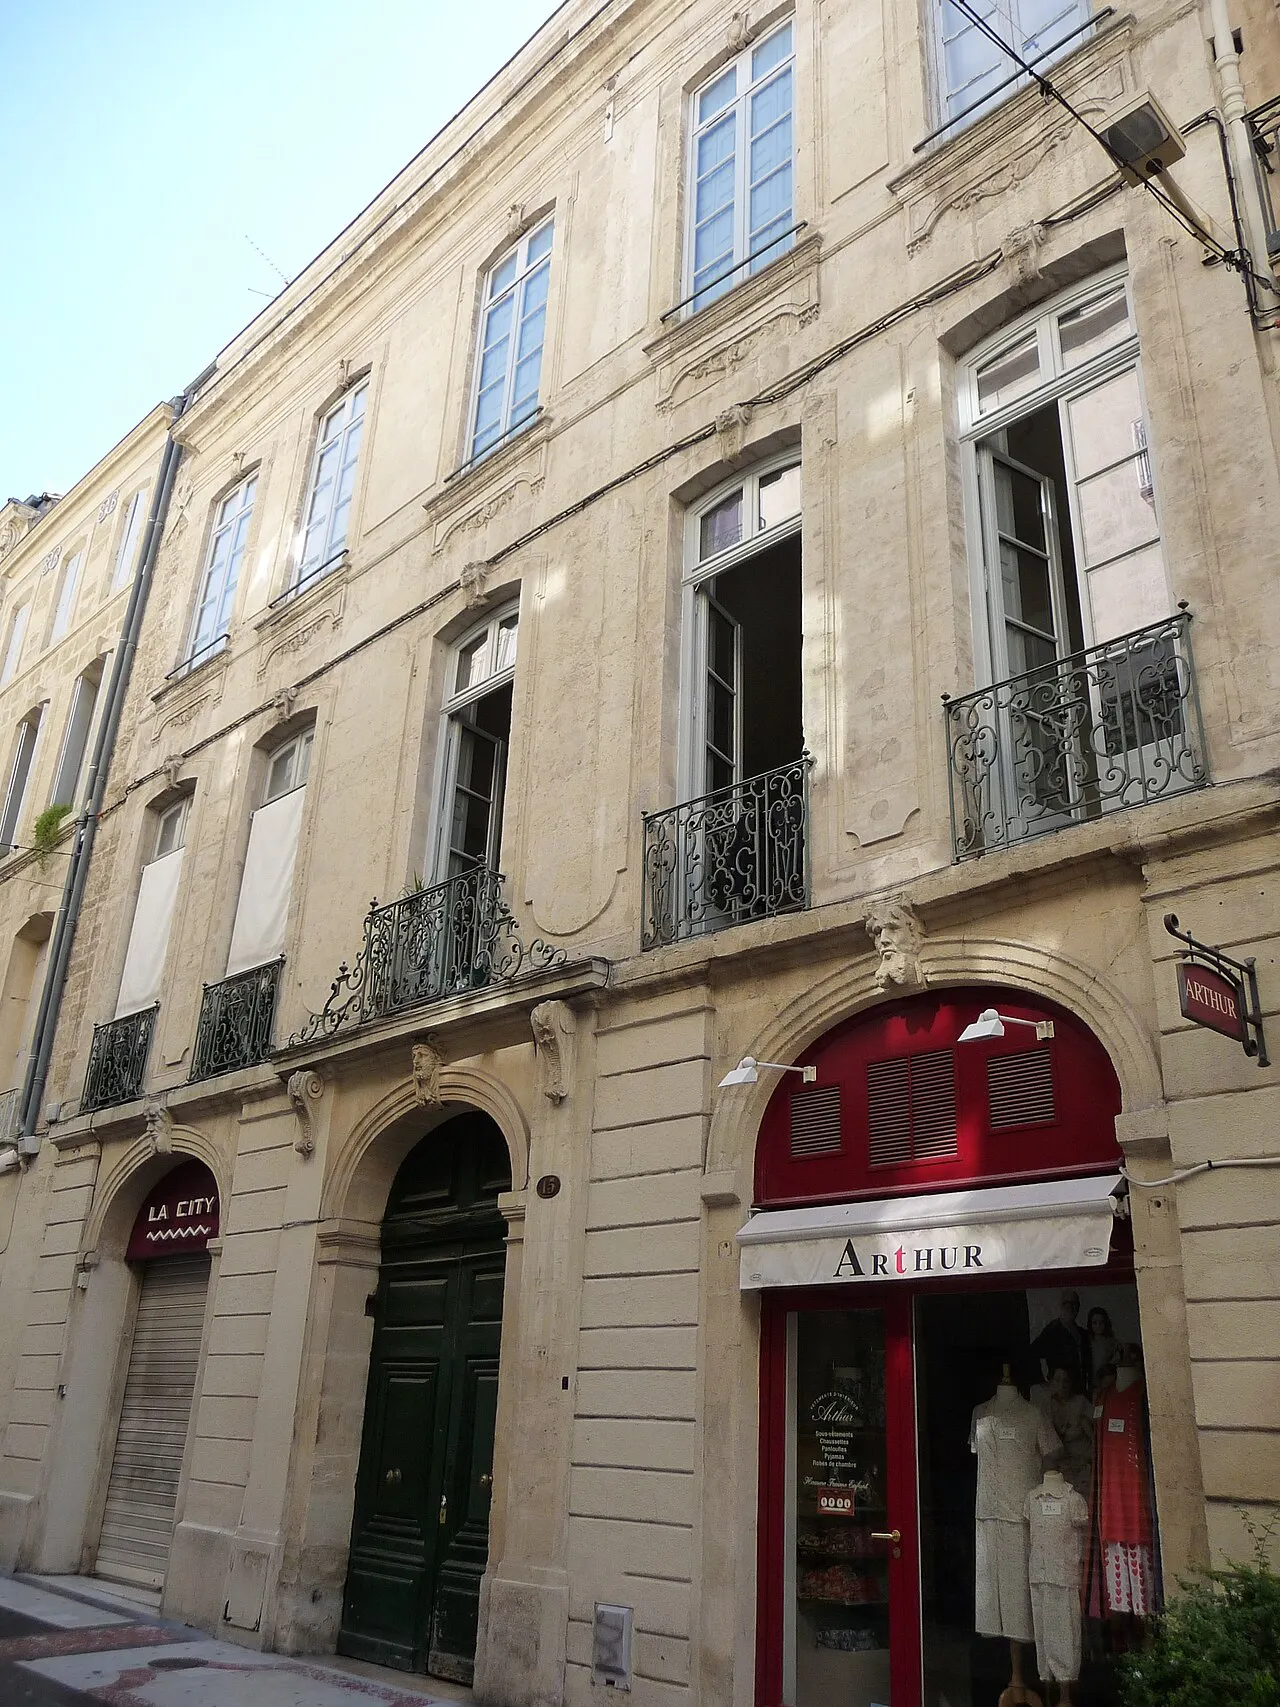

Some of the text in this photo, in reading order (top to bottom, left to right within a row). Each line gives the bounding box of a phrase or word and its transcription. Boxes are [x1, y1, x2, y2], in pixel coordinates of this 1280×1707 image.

[1186, 978, 1237, 1019] ARTHUR
[542, 1177, 555, 1194] 15
[148, 1196, 215, 1221] LA CITY
[811, 1401, 853, 1422] Arthur
[824, 1453, 845, 1461] Pyjamas
